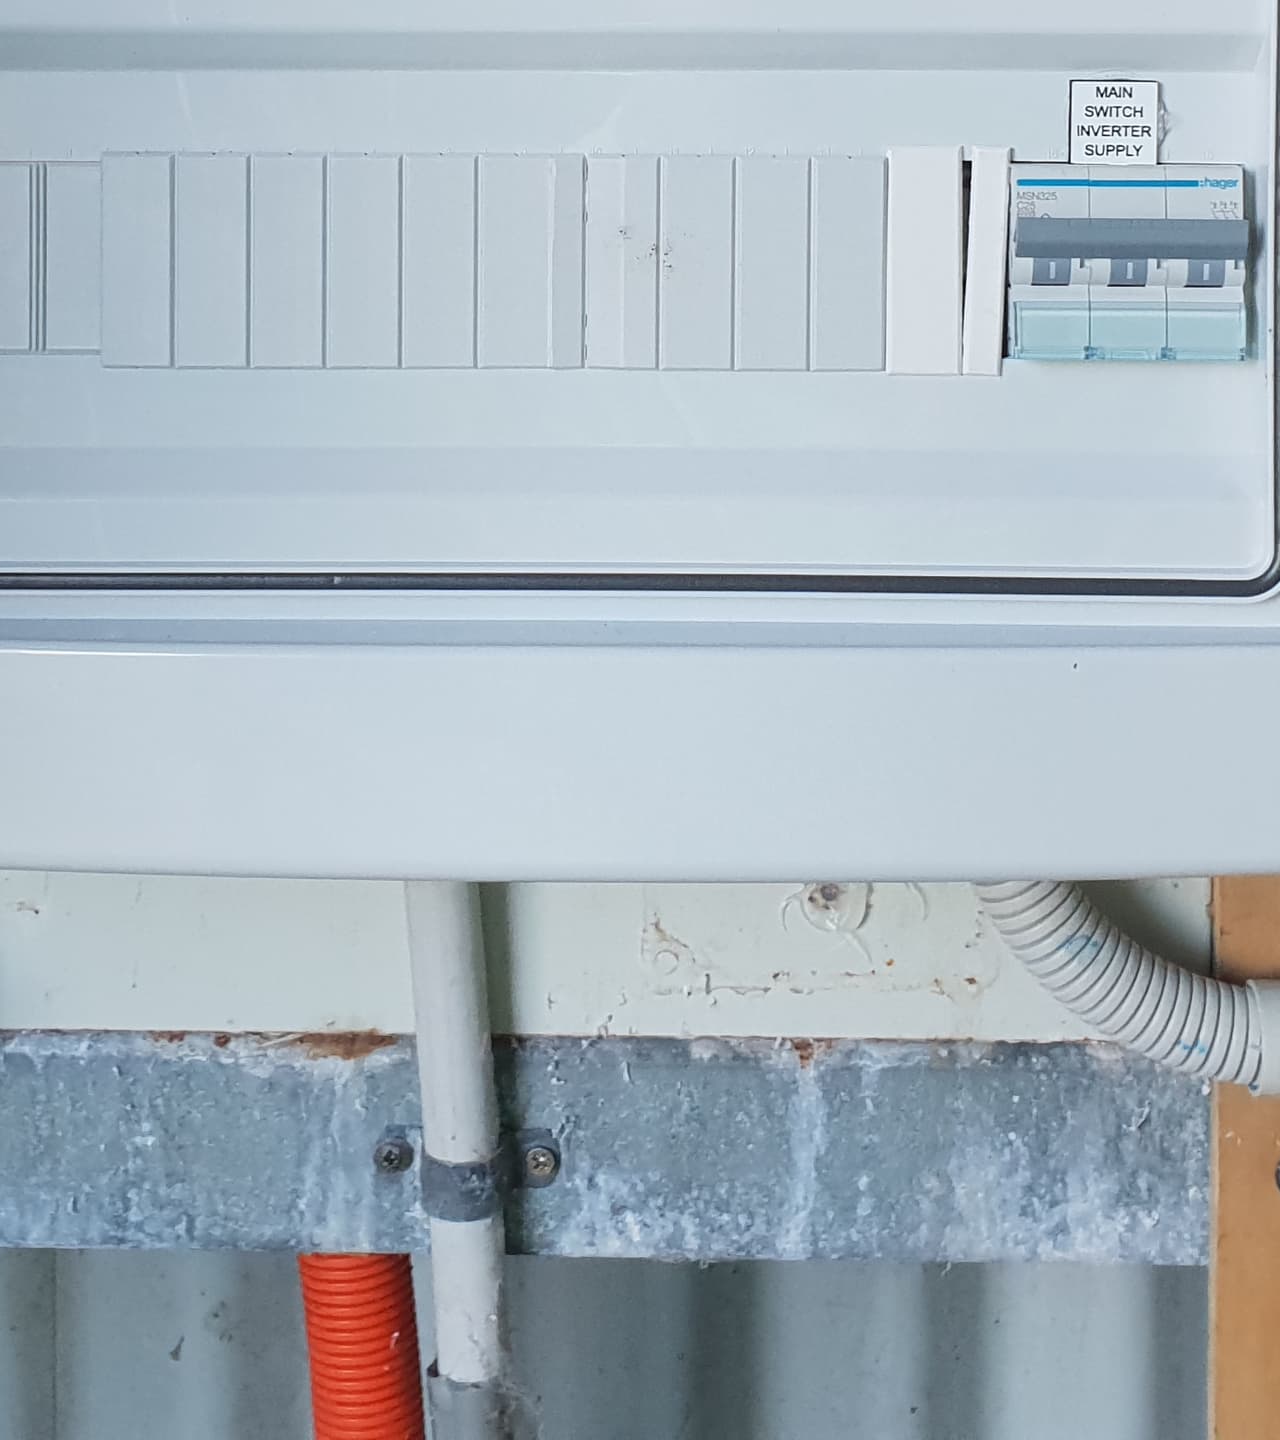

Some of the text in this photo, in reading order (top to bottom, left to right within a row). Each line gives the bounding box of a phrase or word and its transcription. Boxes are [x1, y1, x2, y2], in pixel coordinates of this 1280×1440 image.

[1095, 86, 1133, 98] MAIN
[1084, 106, 1143, 118] SWITCH
[1077, 126, 1152, 137] INVERTER
[1084, 145, 1143, 157] SUPPLY
[1017, 192, 1057, 200] MSN325
